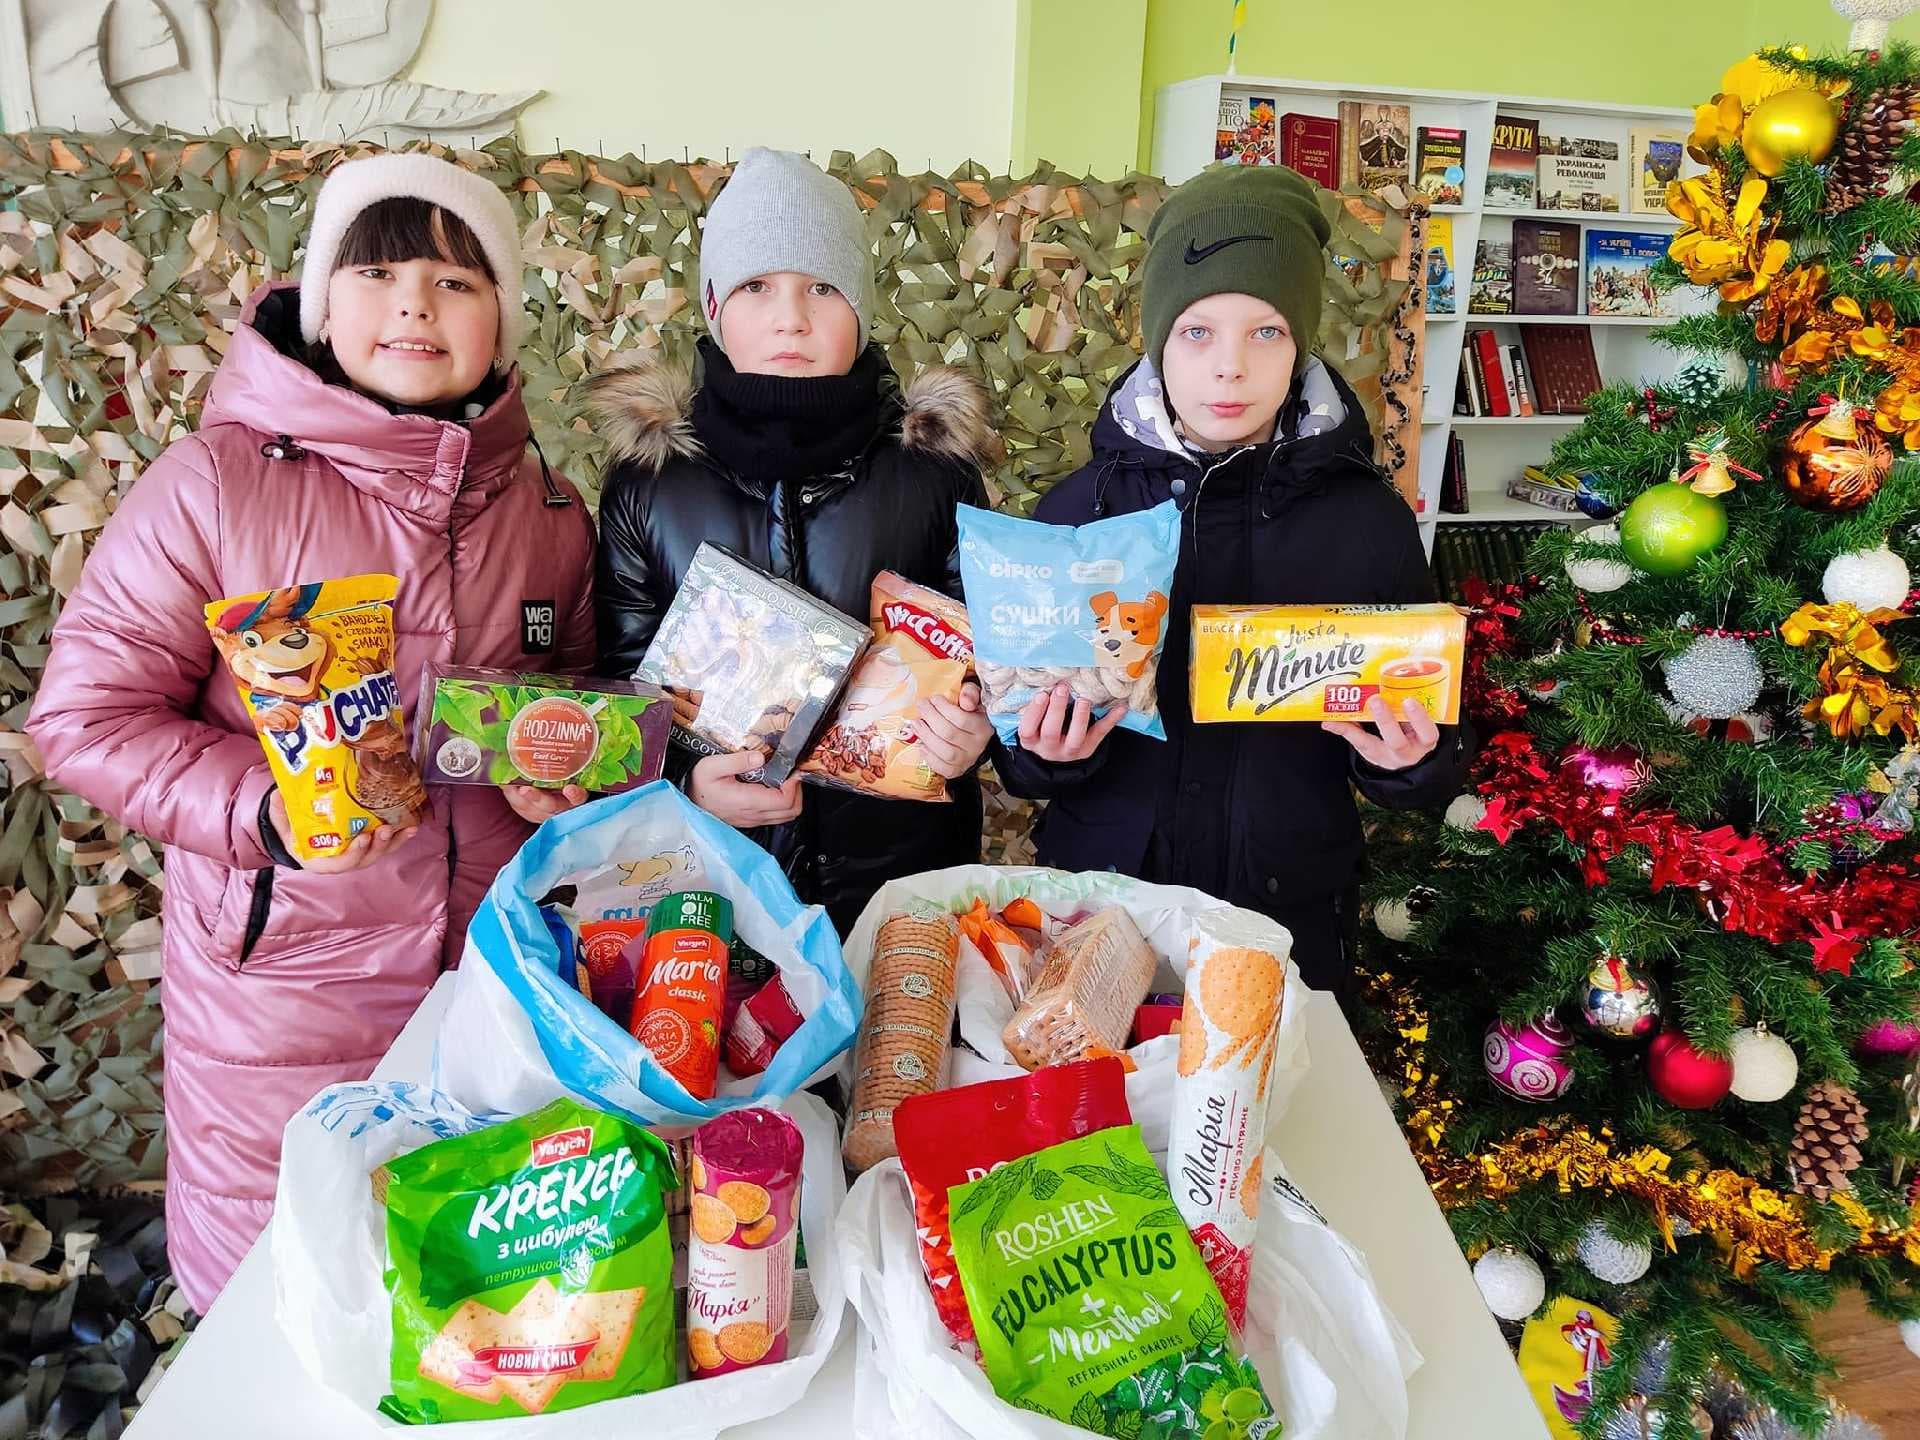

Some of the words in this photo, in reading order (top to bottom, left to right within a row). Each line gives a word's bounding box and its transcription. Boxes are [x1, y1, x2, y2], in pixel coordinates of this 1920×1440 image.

[1556, 158, 1606, 170] УКРАЇНСЬКА
[1556, 168, 1606, 181] РЕВОЛЮЦІЯ
[340, 614, 386, 627] BARDZIEJ
[991, 604, 1081, 625] СУШКИ
[1202, 624, 1234, 633] BLACK
[1235, 624, 1254, 633] EA
[1285, 620, 1323, 649] Just
[1325, 623, 1336, 636] a
[1225, 633, 1366, 711] Minute
[1328, 686, 1361, 703] 100
[523, 719, 587, 742] RODZINNA
[669, 725, 723, 758] BISCOT
[532, 751, 549, 761] Earl
[681, 901, 711, 917] OIL
[682, 893, 713, 905] PALM
[680, 915, 711, 928] FREE
[638, 957, 721, 998] Maria
[668, 986, 708, 1002] classic
[539, 1136, 586, 1158] Yarych
[1181, 1094, 1231, 1207] Марія
[1229, 1158, 1241, 1200] ПЕЧИВО
[1236, 1106, 1249, 1156] ЗАТЯЖНЕ
[467, 1146, 638, 1239] КРЕКЕР
[496, 1243, 510, 1260] з
[516, 1214, 599, 1257] цибулею
[995, 1195, 1117, 1262] ROSHEN
[991, 1233, 1177, 1348] EUCALYPTUS
[541, 1349, 577, 1368] СМАК
[1067, 1350, 1138, 1389] REFRESHING
[1139, 1334, 1184, 1356] CANDIES
